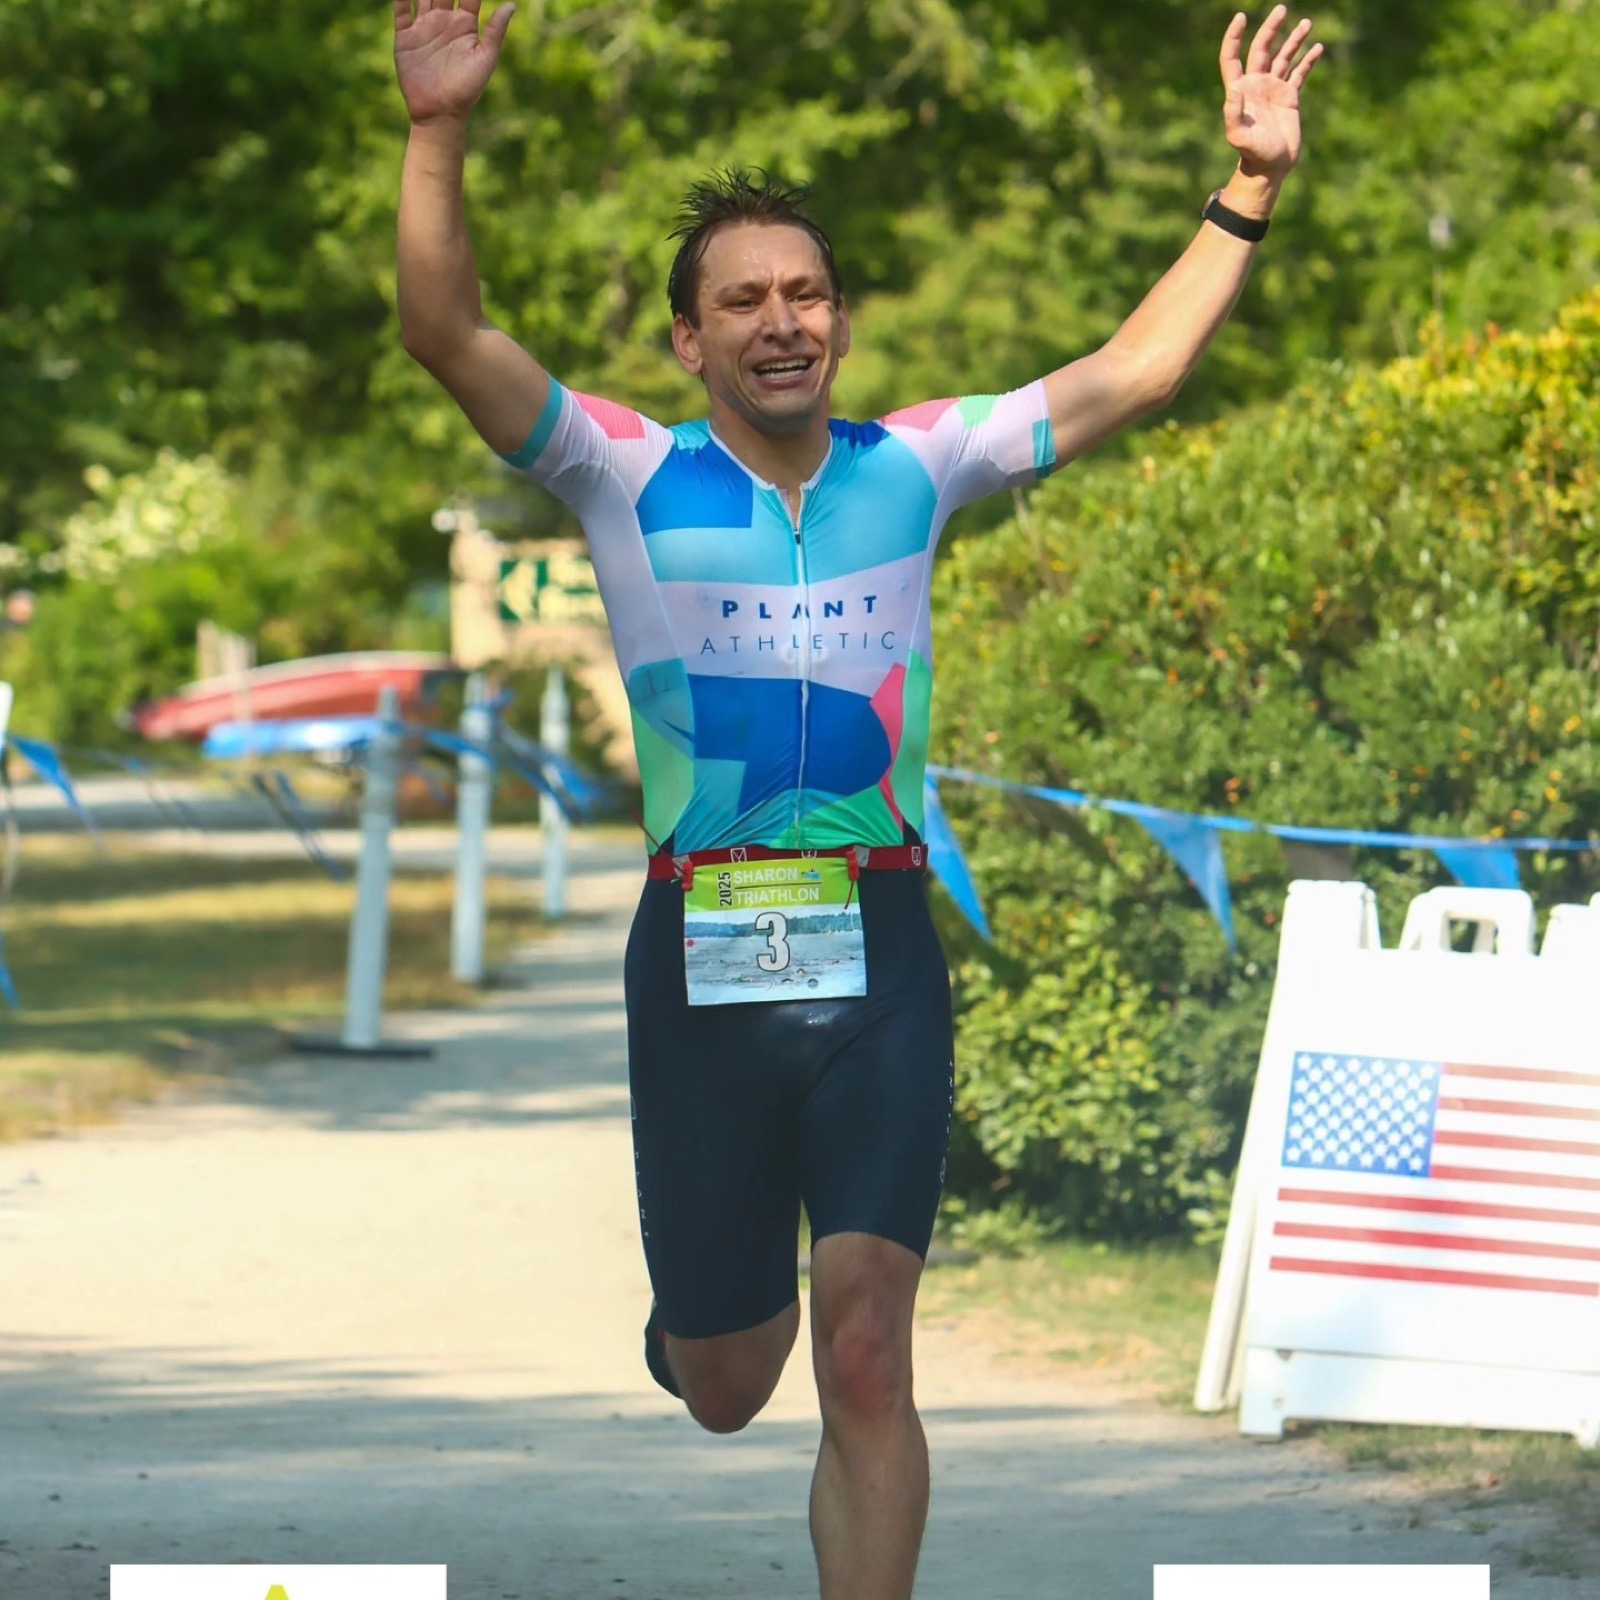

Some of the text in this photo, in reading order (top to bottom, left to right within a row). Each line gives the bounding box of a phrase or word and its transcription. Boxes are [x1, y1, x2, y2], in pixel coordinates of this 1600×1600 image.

[722, 595, 876, 618] PLANT
[700, 631, 895, 655] ATHLETIC
[734, 867, 798, 884] SHARON
[718, 871, 732, 907] 2025
[735, 887, 820, 905] TRIATHLON
[755, 911, 790, 973] 3
